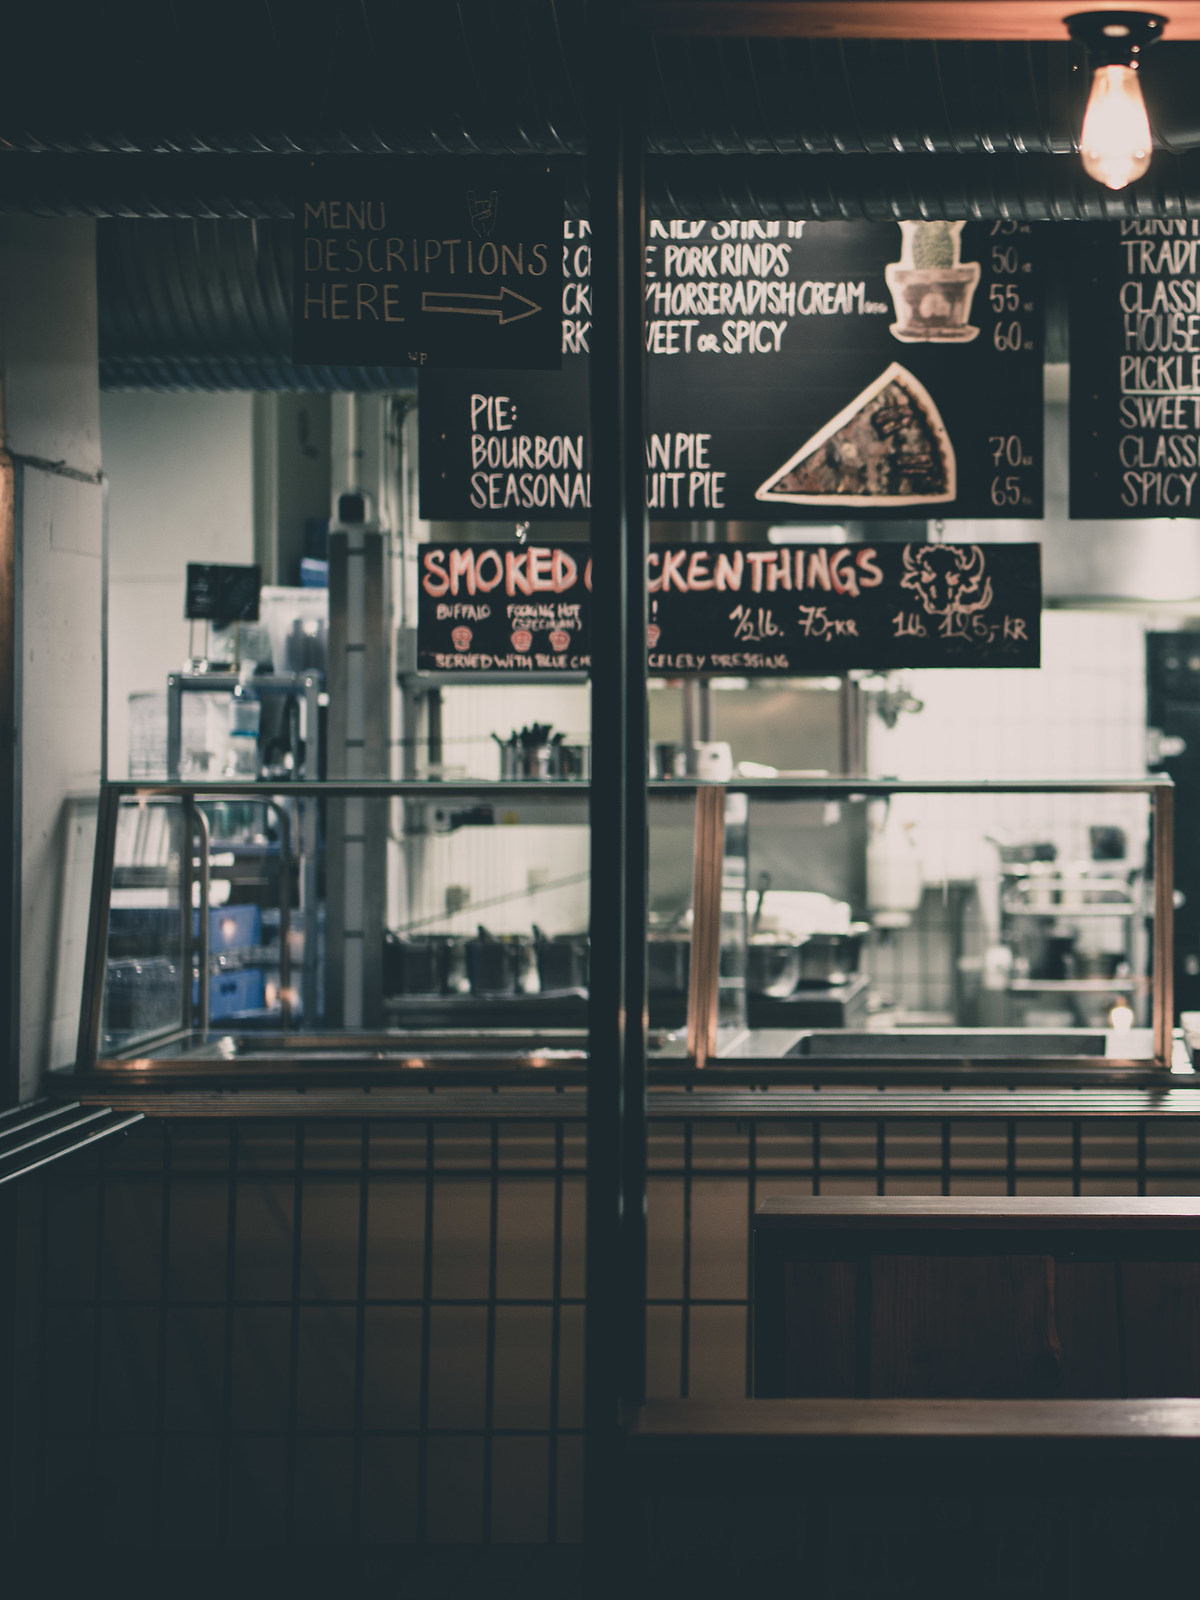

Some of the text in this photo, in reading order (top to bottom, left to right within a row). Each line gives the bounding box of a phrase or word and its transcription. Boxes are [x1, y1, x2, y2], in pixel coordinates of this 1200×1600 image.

[303, 202, 386, 230] MENU
[304, 237, 549, 276] DESCRIPTIONS
[664, 245, 719, 278] PORK
[720, 243, 792, 278] RINDS
[303, 284, 405, 322] HERE
[654, 280, 796, 317] HORSERADISH
[797, 281, 866, 315] CREAM
[646, 320, 699, 354] EET
[722, 320, 788, 353] SPICY
[1123, 312, 1200, 352] HOUSE
[470, 394, 517, 431] PIE:
[471, 434, 584, 471] BOURBON
[675, 432, 712, 470] PIE
[690, 472, 727, 508] PIE
[1120, 470, 1198, 507] SPICY
[422, 546, 578, 597] SMOKED
[436, 602, 491, 621] BUFFALO
[435, 653, 493, 669] SERVED
